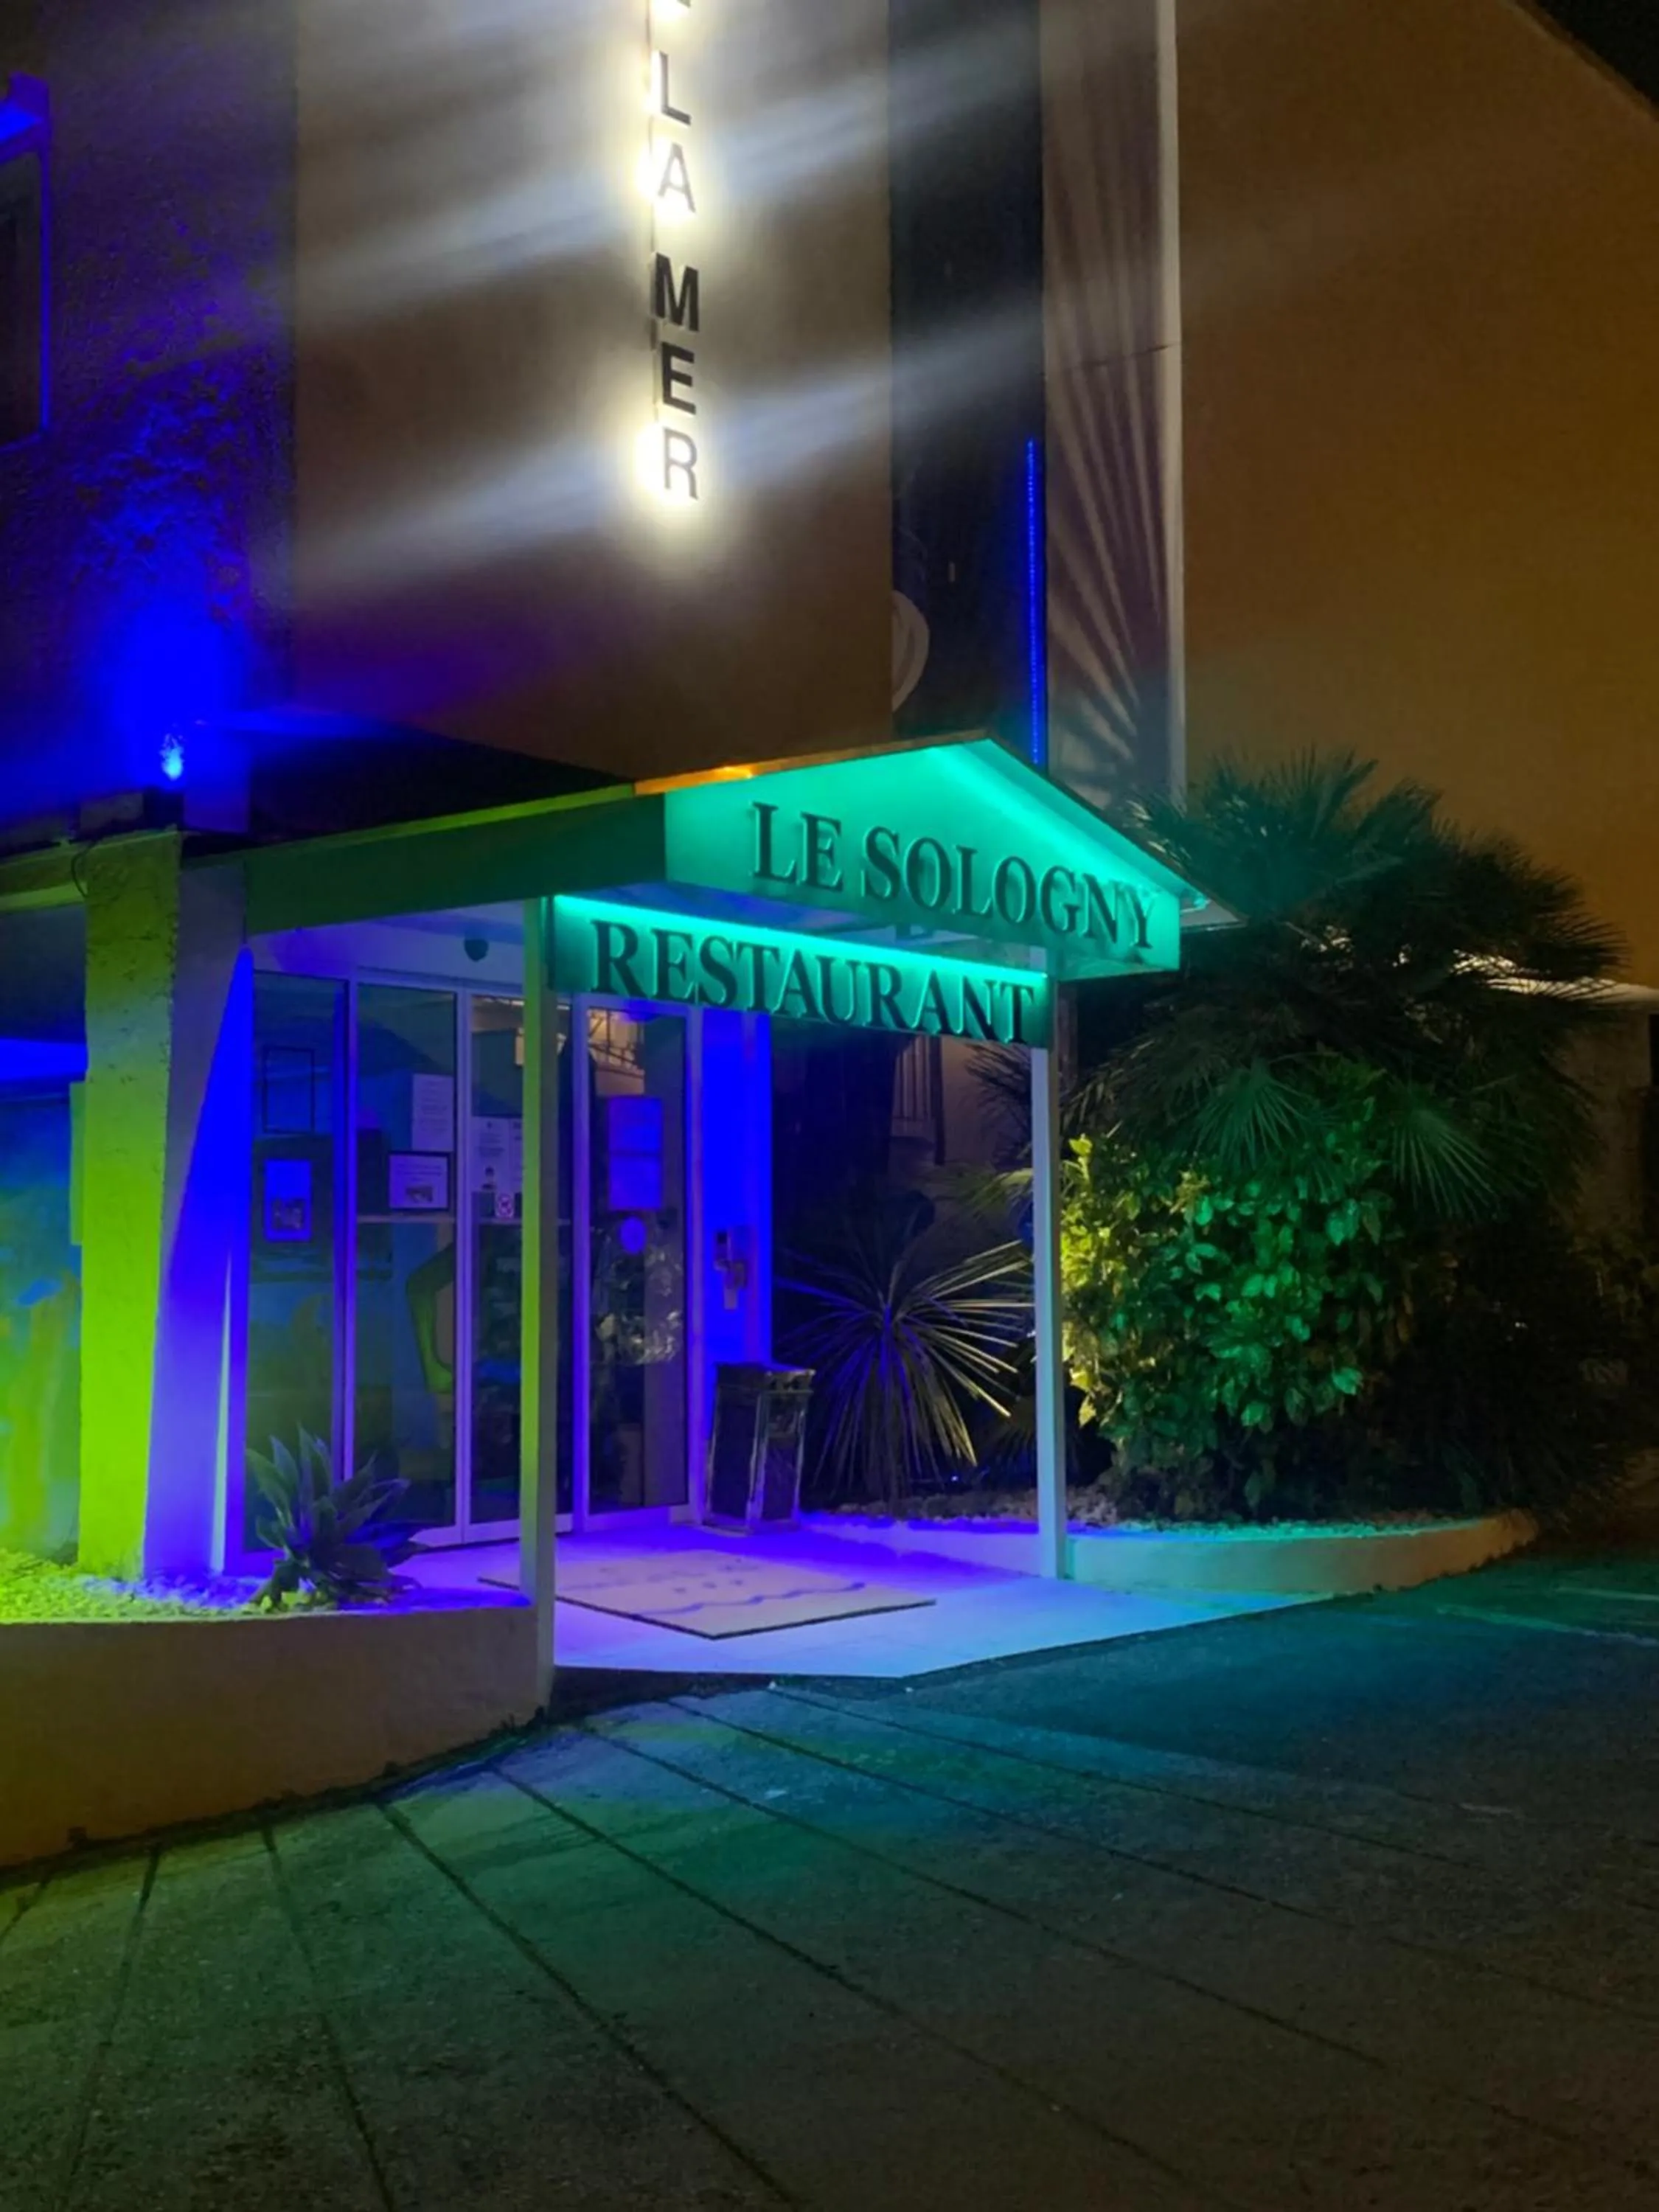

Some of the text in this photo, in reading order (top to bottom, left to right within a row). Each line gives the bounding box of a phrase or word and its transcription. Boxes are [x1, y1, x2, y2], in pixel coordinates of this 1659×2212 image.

[654, 50, 700, 501] LA MER
[752, 801, 1155, 950] LE SOLOGNY
[591, 920, 1033, 1044] RESTAURANT
